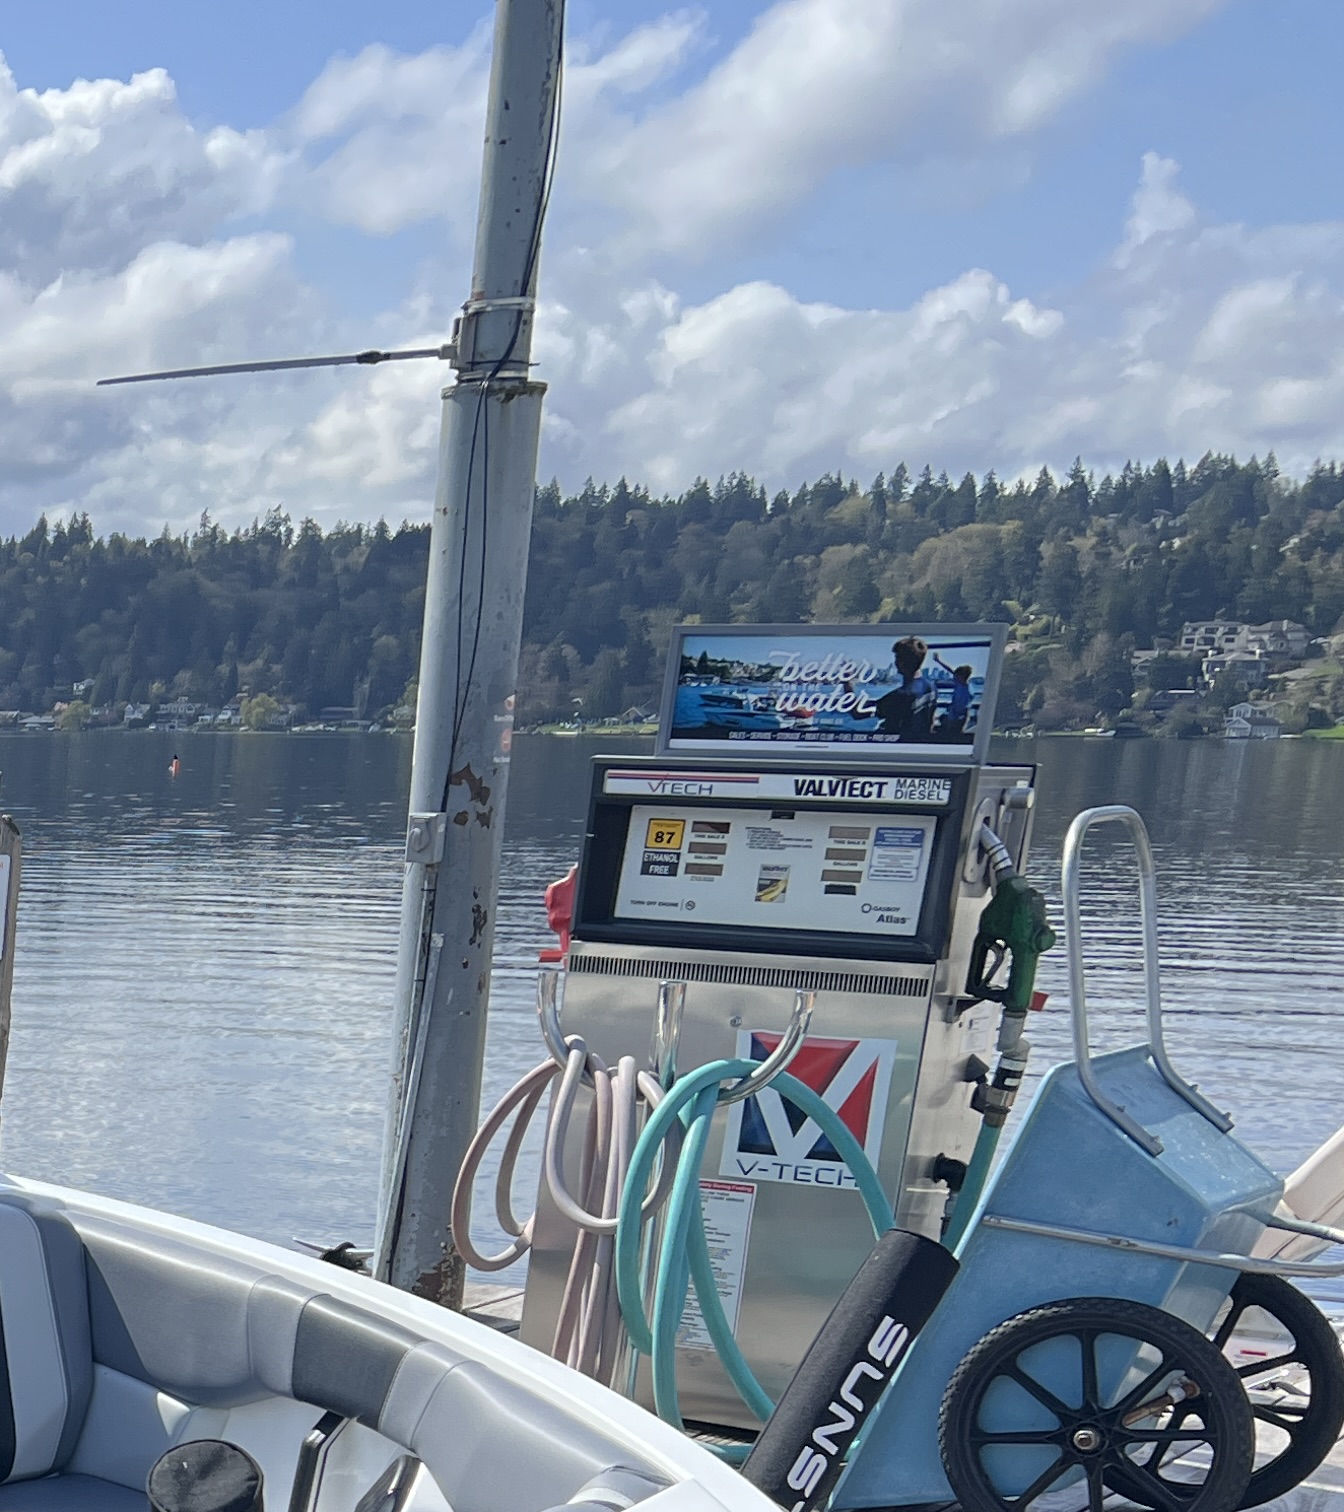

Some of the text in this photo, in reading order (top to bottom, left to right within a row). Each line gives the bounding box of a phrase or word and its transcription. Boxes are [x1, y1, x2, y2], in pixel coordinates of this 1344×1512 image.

[768, 650, 878, 683] better
[775, 689, 877, 717] water
[793, 776, 951, 799] VALVTECT MARINE
[894, 789, 944, 801] DIESEL
[654, 831, 675, 844] 87
[644, 853, 679, 863] ETHANOL
[649, 865, 670, 874] FREE
[876, 914, 907, 924] Atlas
[736, 1159, 857, 1187] V-TECH
